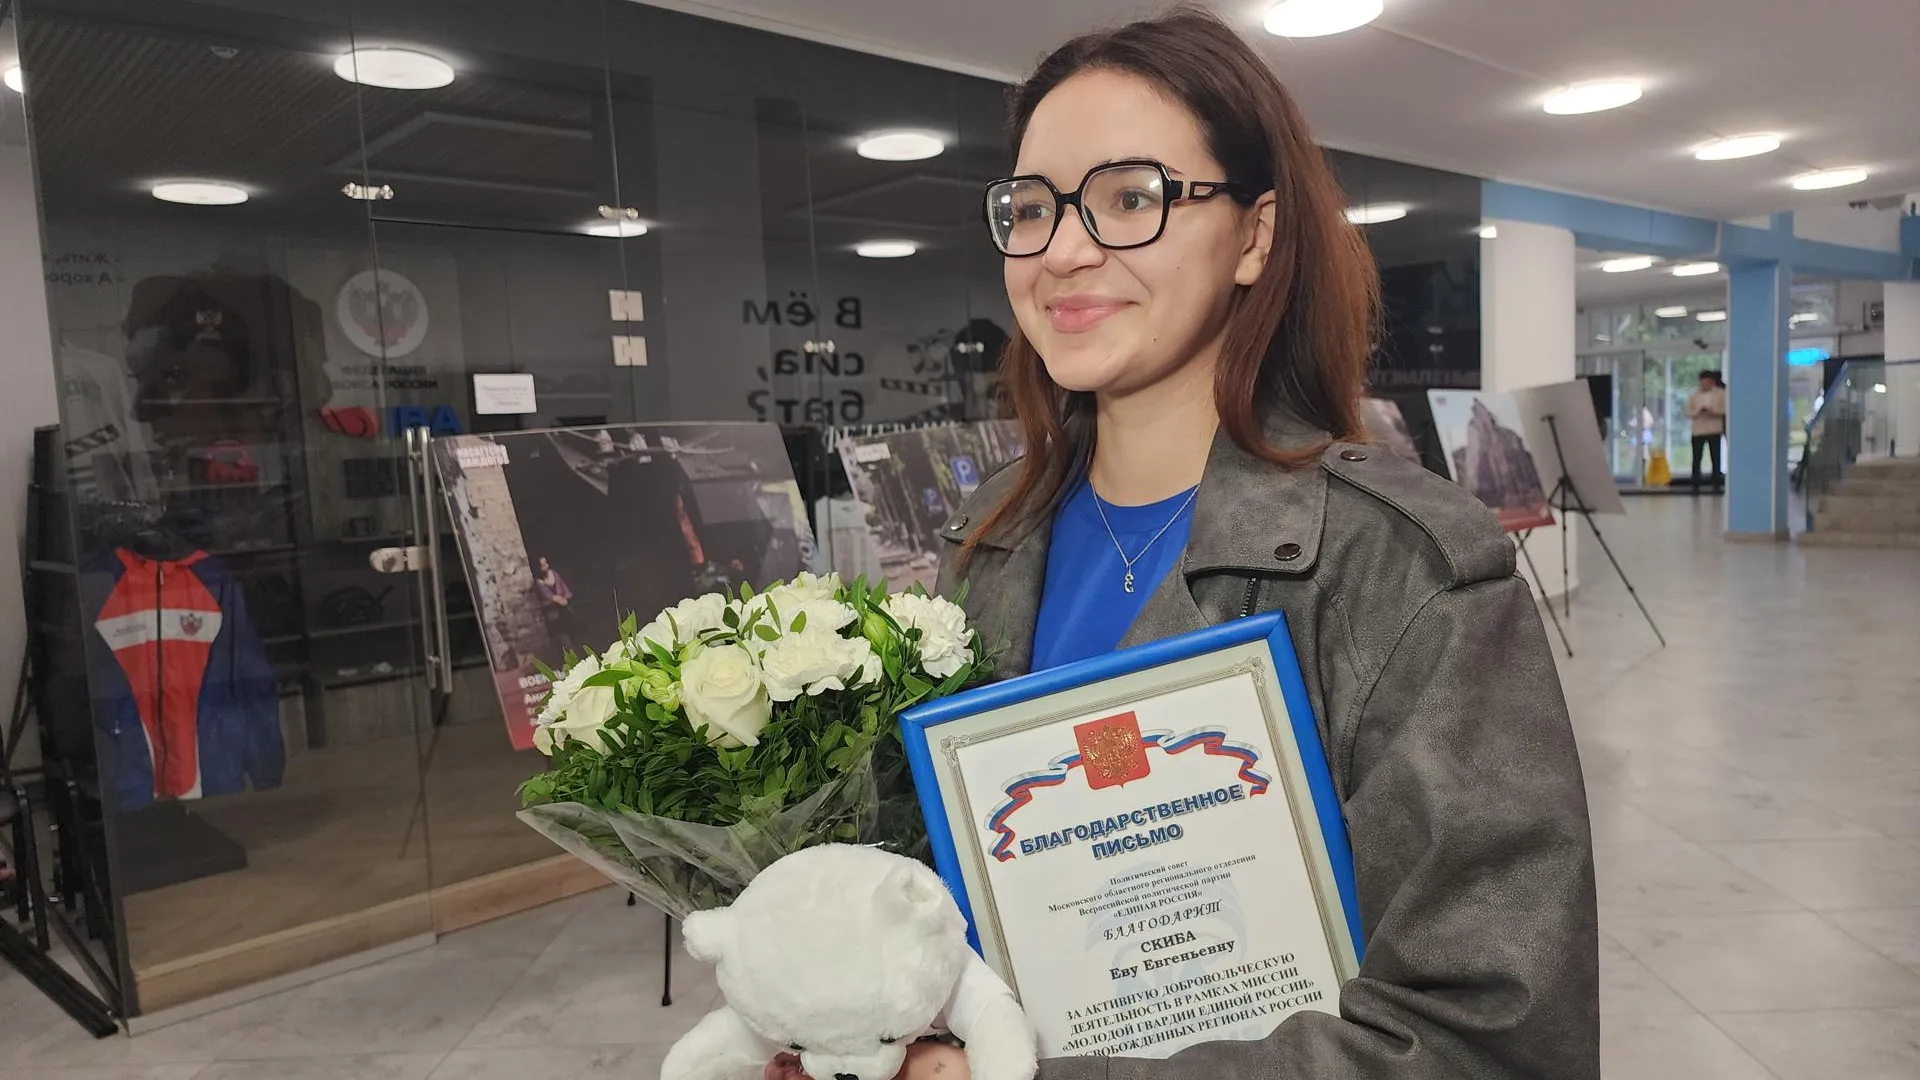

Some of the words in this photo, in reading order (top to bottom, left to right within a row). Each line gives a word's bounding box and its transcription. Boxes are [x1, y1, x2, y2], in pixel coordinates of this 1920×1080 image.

[1019, 784, 1244, 856] БЛАГОДАРСТВЕННОЕ
[1091, 824, 1184, 860] ПИСЬМО
[1048, 894, 1102, 913] Московского
[1104, 882, 1150, 899] областного
[1151, 866, 1212, 888] регионального
[1213, 854, 1256, 870] отделения
[1079, 894, 1140, 917] Всероссийской
[1141, 878, 1200, 900] политической
[1201, 872, 1231, 886] партии
[1109, 864, 1166, 886] Политический
[1167, 861, 1188, 871] совет
[1103, 899, 1222, 941] БЛАГОДАРИТ
[1113, 901, 1157, 918] «ЕДИНАЯ
[1158, 890, 1203, 908] РОССИЯ»
[1109, 965, 1139, 980] Еву
[1143, 940, 1235, 972] Евгеньевну
[1140, 930, 1197, 953] СКИБА
[1065, 1009, 1081, 1021] ЗА
[1084, 988, 1159, 1017] АКТИВНУЮ
[1162, 952, 1295, 997] ДОБРОВОЛЬЧЕСКУЮ
[1070, 1000, 1172, 1036] ДЕЯТЕЛЬНОСТЬ
[1174, 997, 1183, 1008] В
[1185, 983, 1240, 1005] РАМКАХ
[1241, 966, 1299, 990] МИССИИ
[1062, 1022, 1134, 1053] «МОЛОДОЙ
[1137, 1008, 1196, 1034] ГВАРДИИ
[1198, 992, 1253, 1017] ЕДИНОЙ
[1255, 979, 1314, 1001] РОССИИ»
[1198, 1006, 1267, 1032] РЕГИОНАХ
[1269, 990, 1323, 1013] РОССИИ
